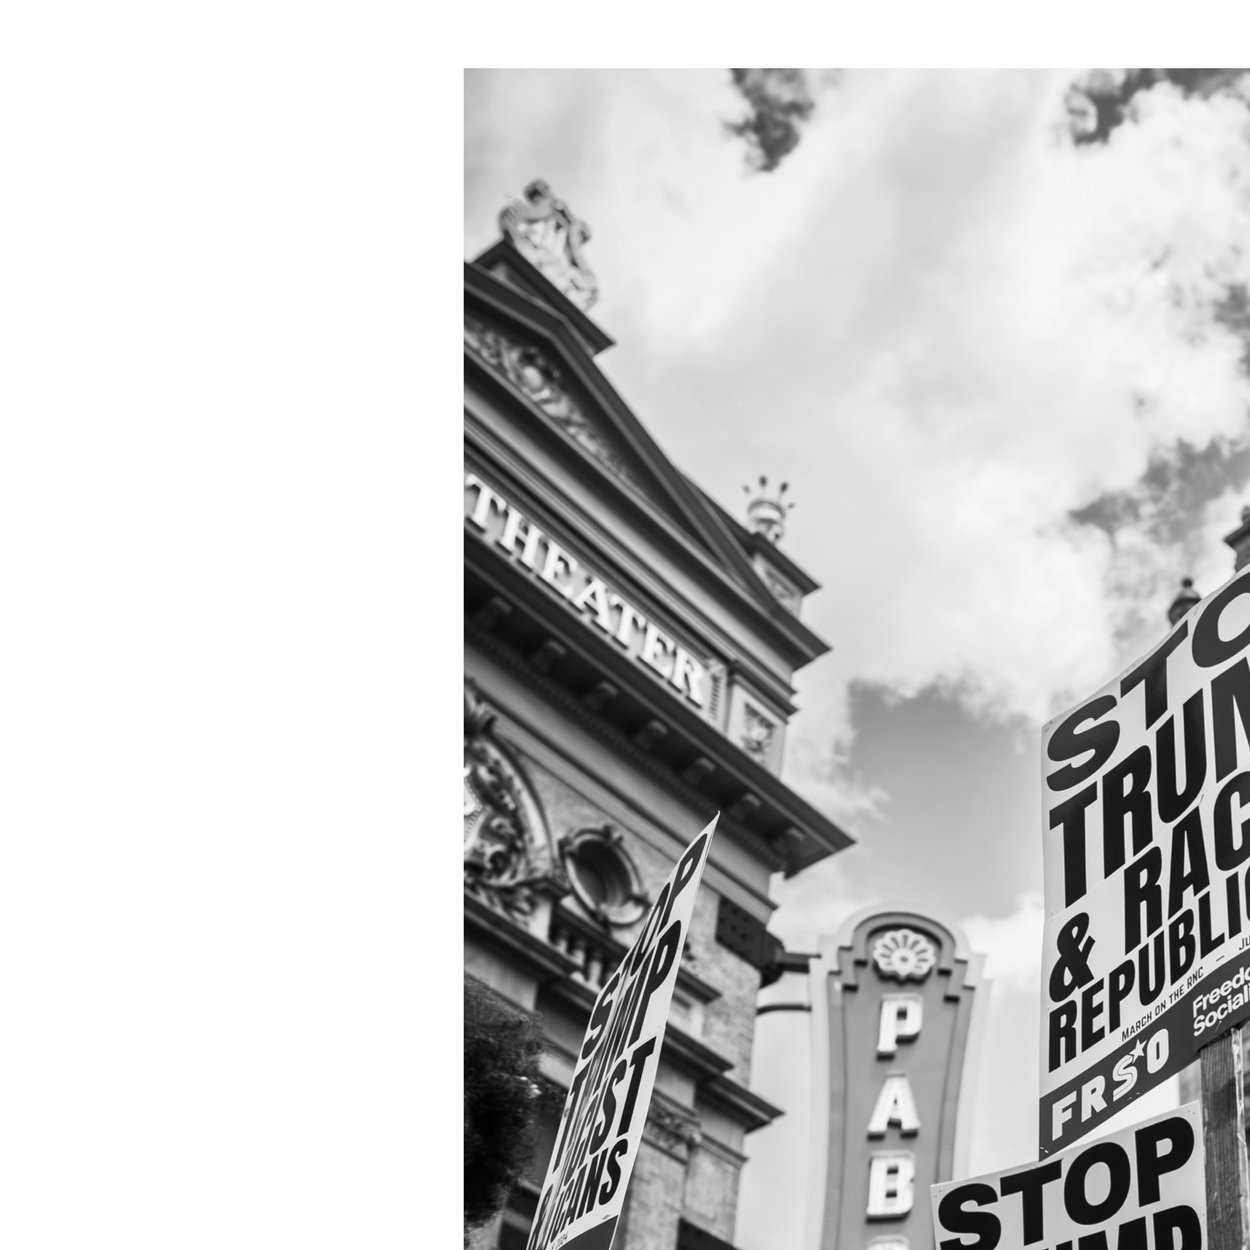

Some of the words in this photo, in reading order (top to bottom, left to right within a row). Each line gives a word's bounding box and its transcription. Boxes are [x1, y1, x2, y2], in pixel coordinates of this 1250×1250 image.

[464, 473, 704, 710] THEATER
[1048, 911, 1096, 1003] &
[1121, 1010, 1153, 1042] MARCH
[1154, 1000, 1167, 1017] ON
[1168, 984, 1185, 1005] THE
[1186, 966, 1204, 990] RNC
